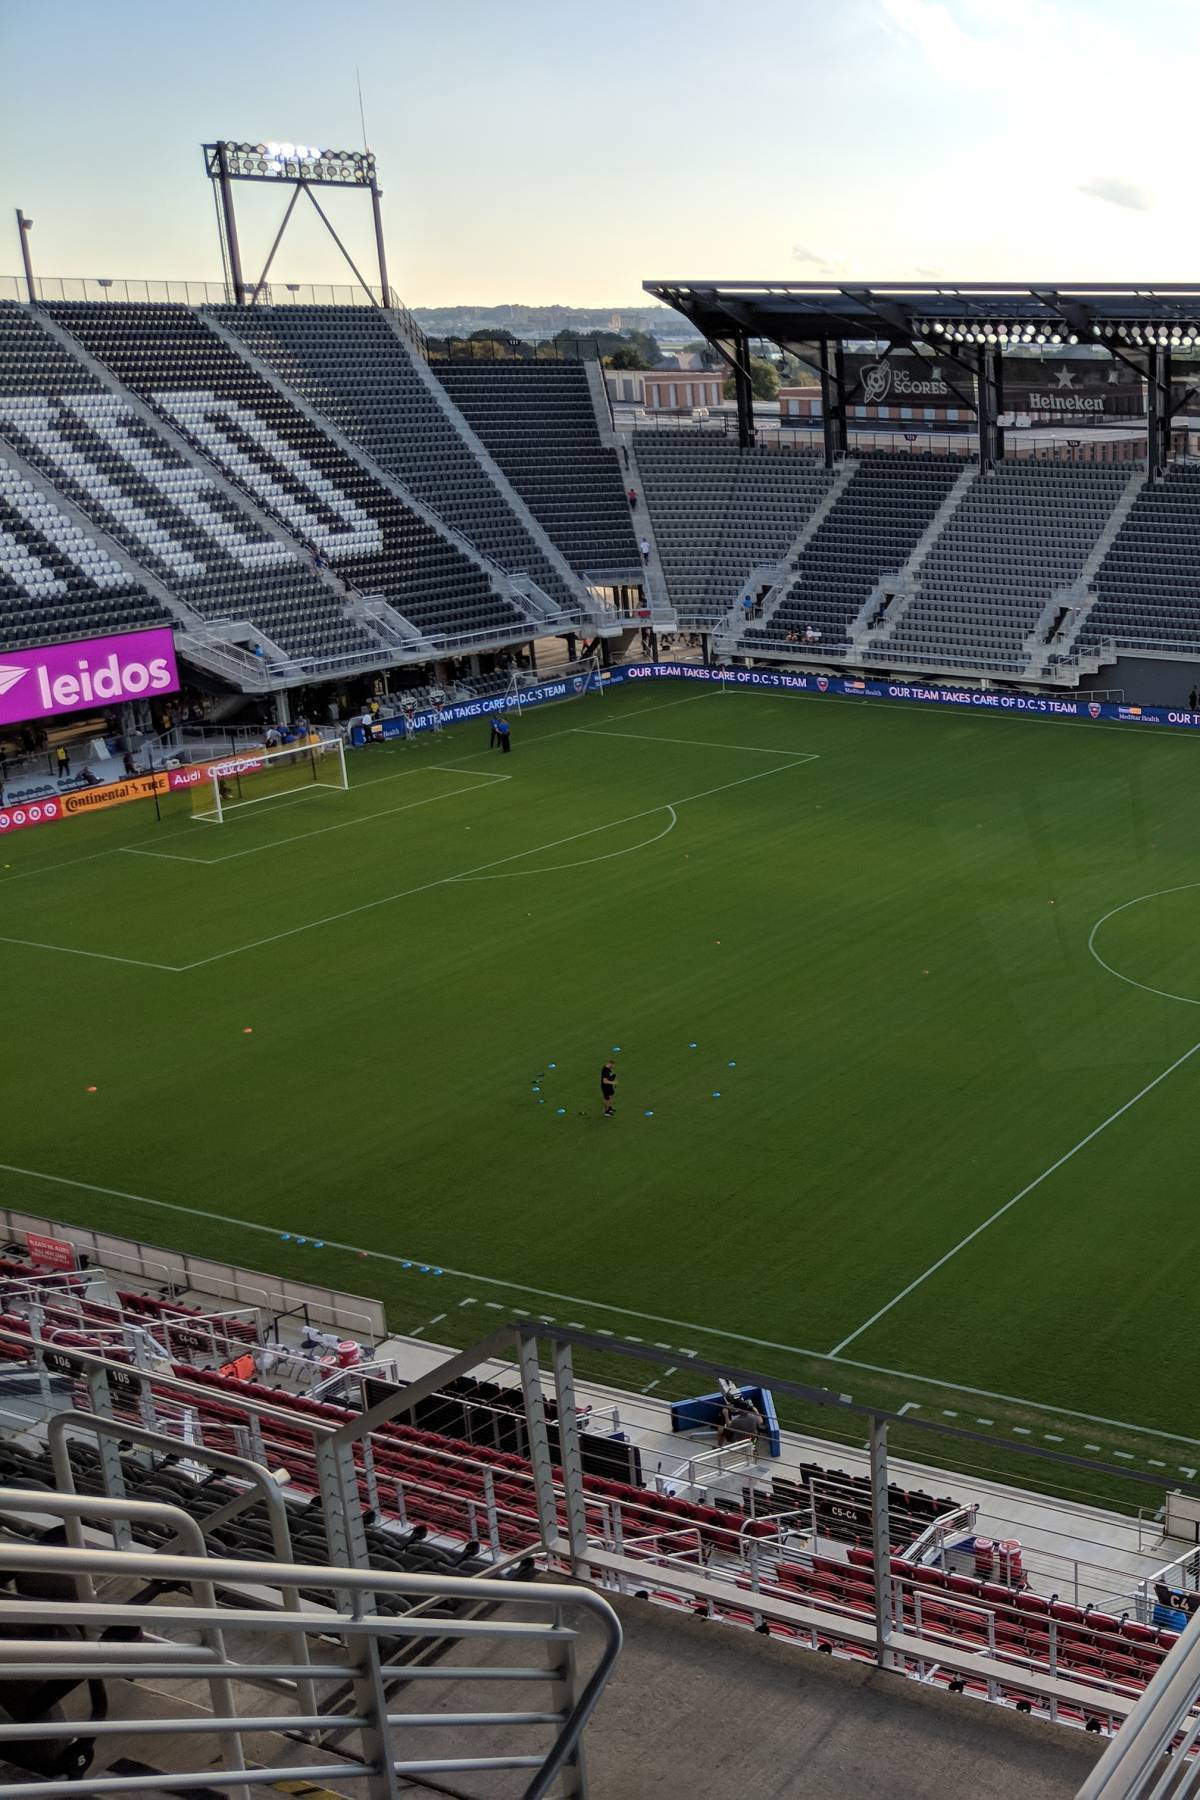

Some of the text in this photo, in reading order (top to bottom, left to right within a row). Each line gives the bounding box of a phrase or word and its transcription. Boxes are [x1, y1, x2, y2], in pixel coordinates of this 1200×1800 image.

[893, 370, 909, 381] DC
[894, 381, 948, 395] SCORES
[1029, 393, 1105, 411] Heineken
[37, 653, 171, 709] leidos
[628, 667, 651, 677] OUR
[654, 666, 681, 676] TEAM
[683, 667, 710, 679] TAKES
[711, 669, 735, 681] CARE
[737, 671, 751, 682] OF
[781, 675, 807, 688] TEAM
[408, 714, 426, 729] OUR
[428, 711, 453, 728] TEAM
[454, 704, 481, 719] TAKES
[482, 700, 506, 712] CARE
[507, 695, 519, 706] OF
[542, 683, 566, 699] TEAM
[889, 686, 910, 697] OUR
[912, 688, 939, 701] TEAM
[941, 691, 970, 704] TAKES
[972, 694, 999, 706] CARE
[1001, 697, 1016, 708] OF
[1048, 701, 1077, 714] TEAM
[1119, 713, 1160, 723] MedStar Health
[1167, 712, 1191, 725] OUR
[174, 770, 201, 785] Audi
[65, 778, 166, 812] Continental TIRE
[53, 1354, 71, 1368] 106
[112, 1371, 130, 1384] 105
[831, 1506, 857, 1520] C5-C4
[1171, 1594, 1190, 1611] C4
